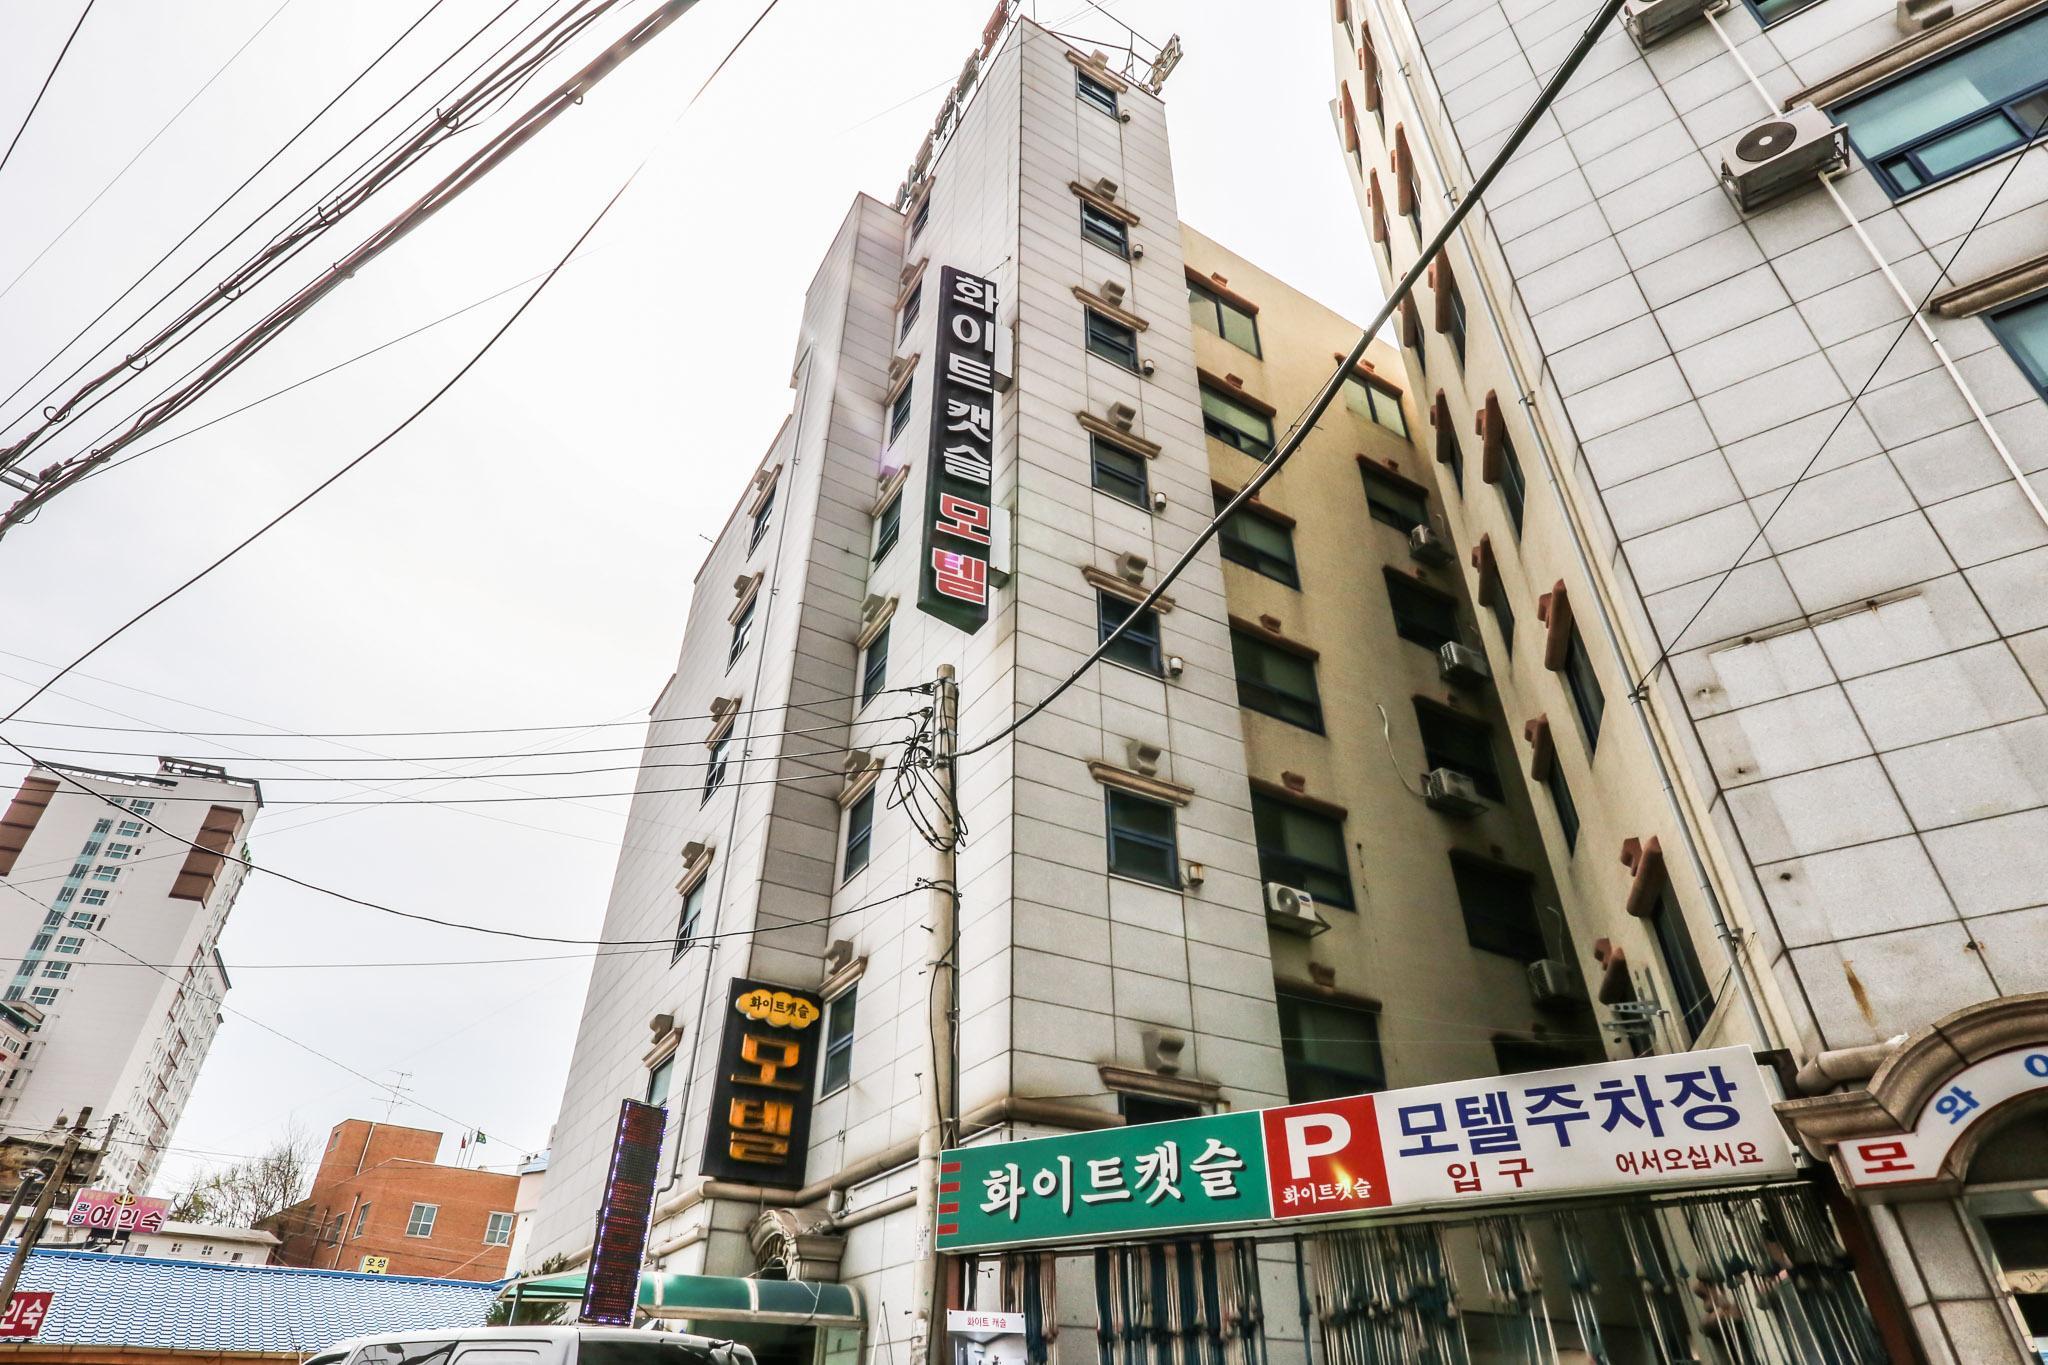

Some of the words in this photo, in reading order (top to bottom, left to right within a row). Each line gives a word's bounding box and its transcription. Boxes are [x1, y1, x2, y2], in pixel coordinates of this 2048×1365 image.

[943, 274, 998, 487] 화이트캣슬
[932, 491, 992, 606] 모텔
[750, 996, 810, 1019] 화이트캣슬
[729, 1033, 804, 1165] 모텔
[1398, 1065, 1741, 1157] 모텔주차장
[1285, 1112, 1352, 1179] P
[1616, 1141, 1764, 1176] 어서오십시요
[979, 1138, 1244, 1221] 화이트캣슬
[1283, 1177, 1372, 1206] 화이트캣슬
[91, 1205, 162, 1232] 여인숙
[366, 1258, 386, 1268] 오성
[967, 1315, 990, 1327] 화이트
